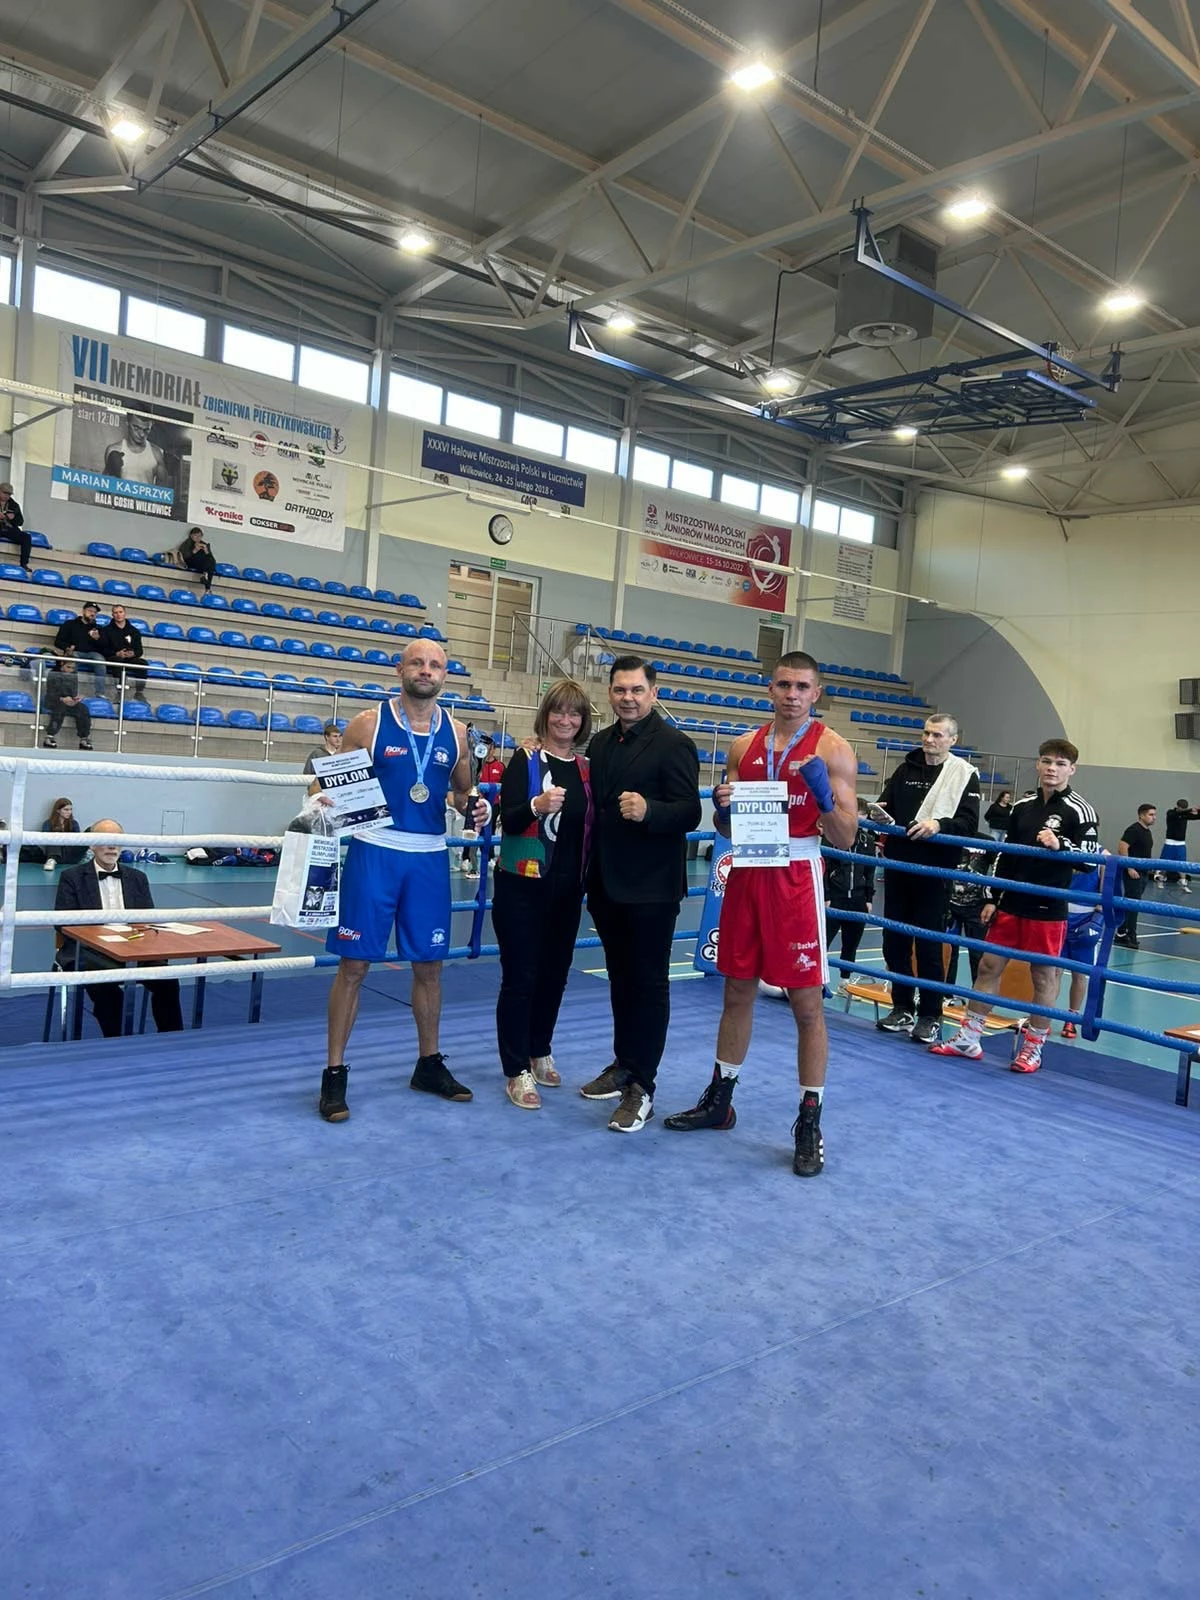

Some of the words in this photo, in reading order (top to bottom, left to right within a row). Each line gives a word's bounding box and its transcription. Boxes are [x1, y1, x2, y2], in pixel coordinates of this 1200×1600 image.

[72, 334, 109, 384] VII
[110, 358, 201, 408] MEMORIAŁ
[203, 395, 250, 420] ZBIGNIEWA
[253, 407, 332, 440] PIETRZYKOWSKIEGO
[427, 437, 450, 453] XXXVI
[451, 444, 477, 460] Halowe
[479, 452, 519, 472] Mistrzostwa
[520, 463, 540, 477] Polski
[541, 471, 547, 479] w
[62, 469, 110, 489] MARIAN
[116, 481, 172, 500] KASPRZYK
[535, 484, 549, 495] 2018
[95, 492, 112, 506] HALA
[136, 499, 172, 517] WILKOWICE
[206, 506, 244, 521] Kronika
[285, 502, 334, 519] ORTHODOX
[252, 519, 279, 529] BOKSER
[664, 523, 703, 539] JUNIORÓW
[704, 533, 745, 550] MŁODSZYCH
[665, 511, 719, 533] MISTRZOSTWA
[720, 525, 746, 540] POLSKI
[324, 768, 370, 788] DYPLOM
[737, 801, 783, 813] DYPLOM
